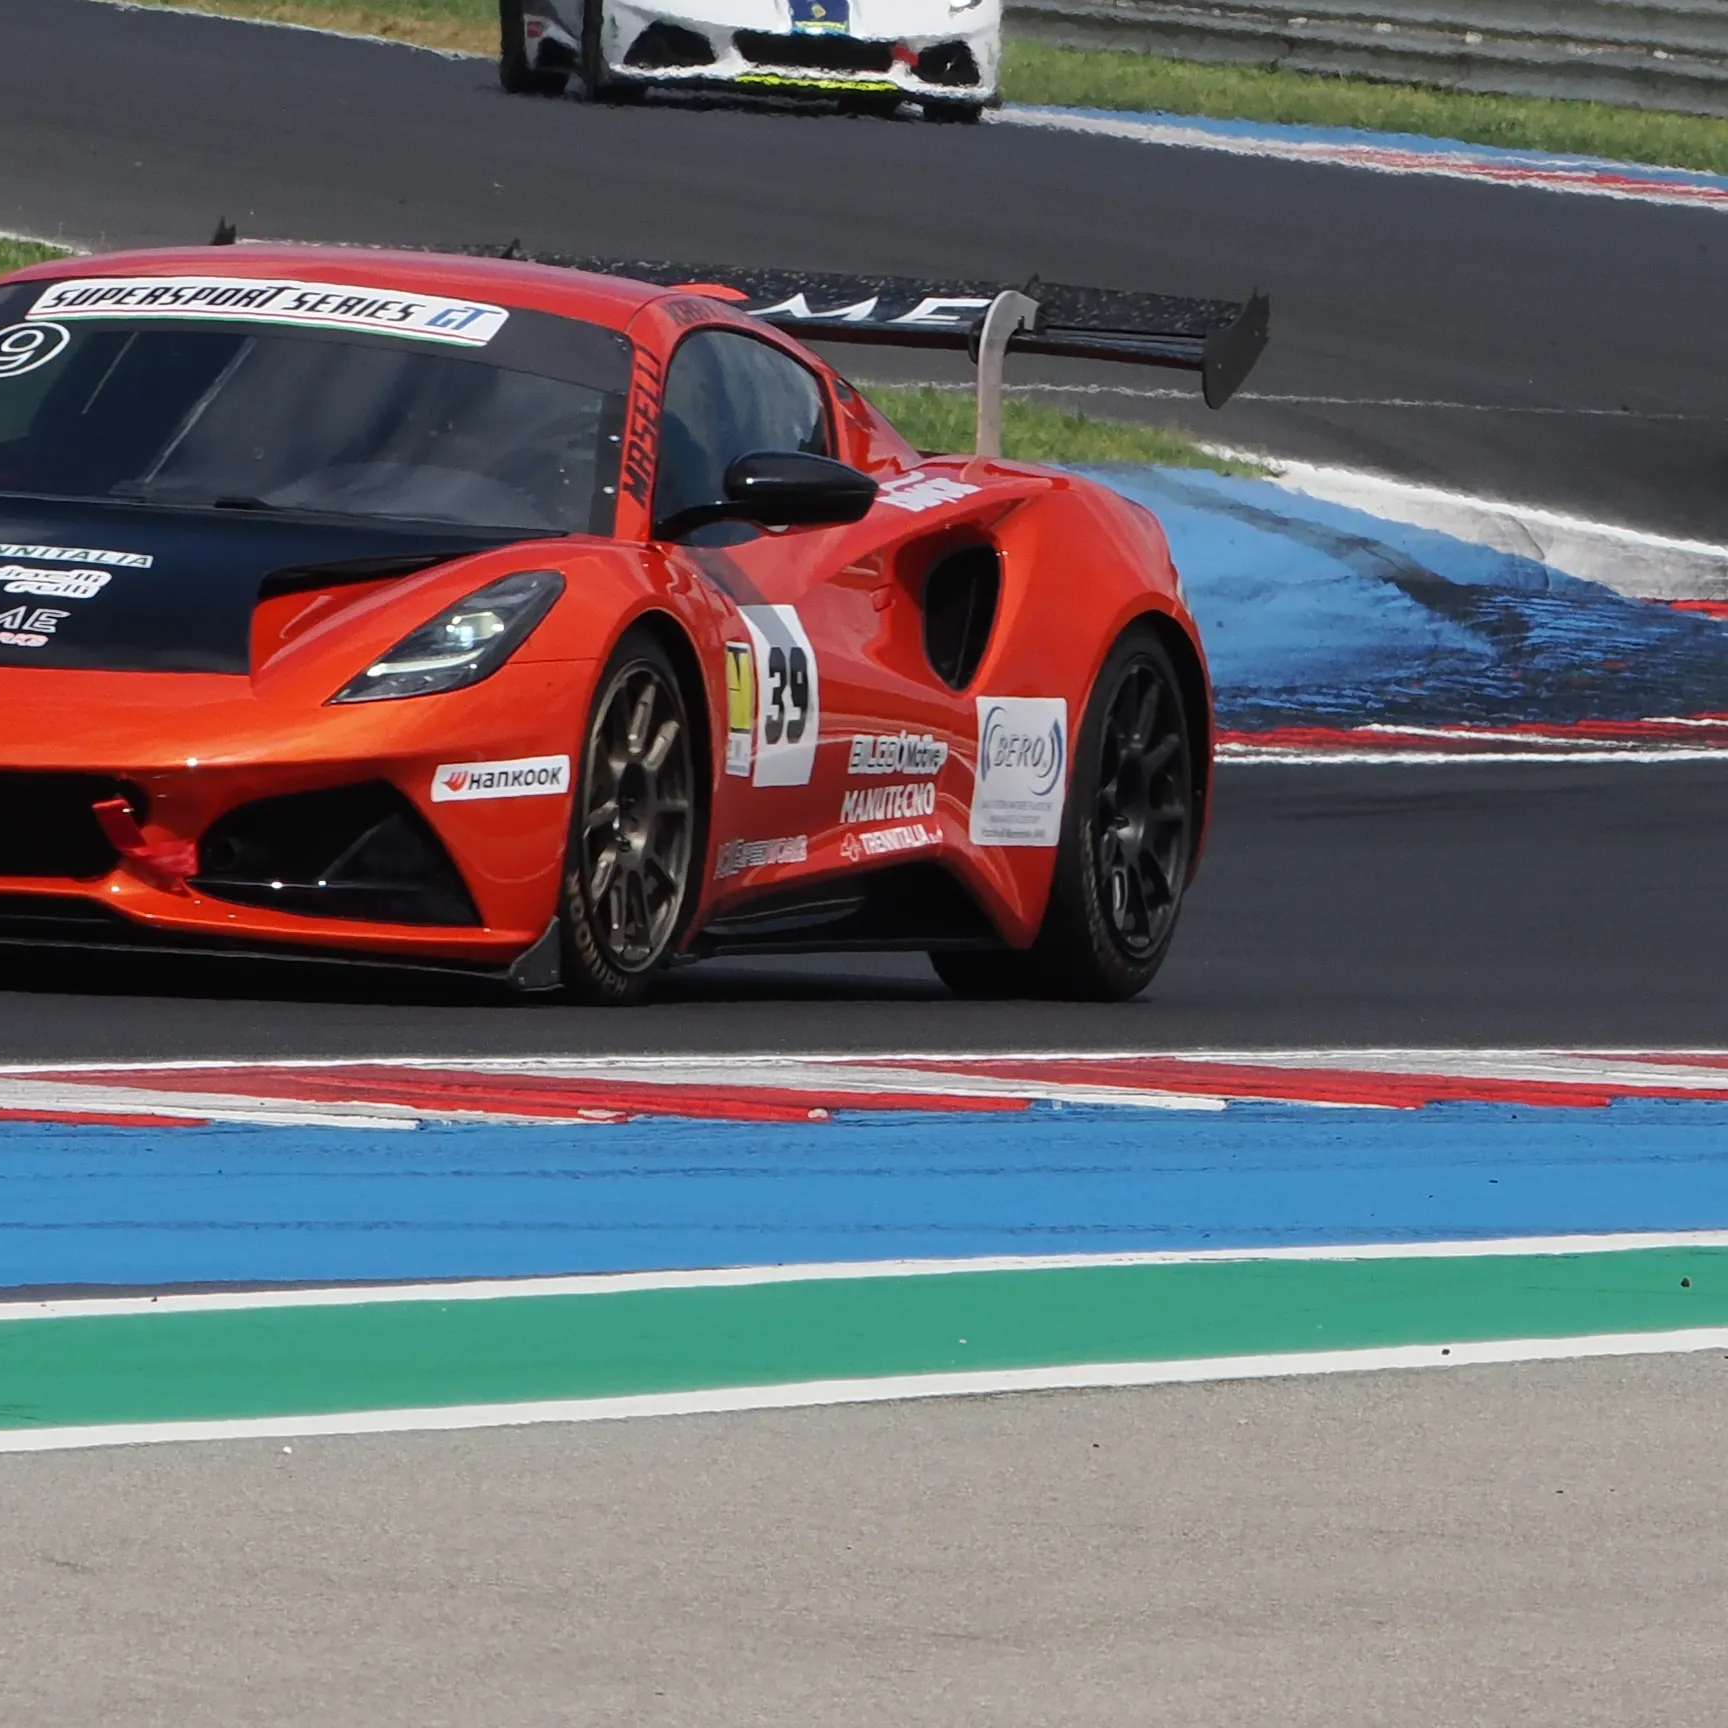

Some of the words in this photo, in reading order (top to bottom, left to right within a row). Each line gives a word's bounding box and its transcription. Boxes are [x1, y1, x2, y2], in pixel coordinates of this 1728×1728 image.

[41, 284, 298, 309] SUPERSPORT
[292, 292, 427, 322] SERIES
[424, 304, 502, 331] GT
[622, 344, 662, 510] MASELLI
[765, 647, 809, 745] 39
[994, 735, 1046, 768] BERO
